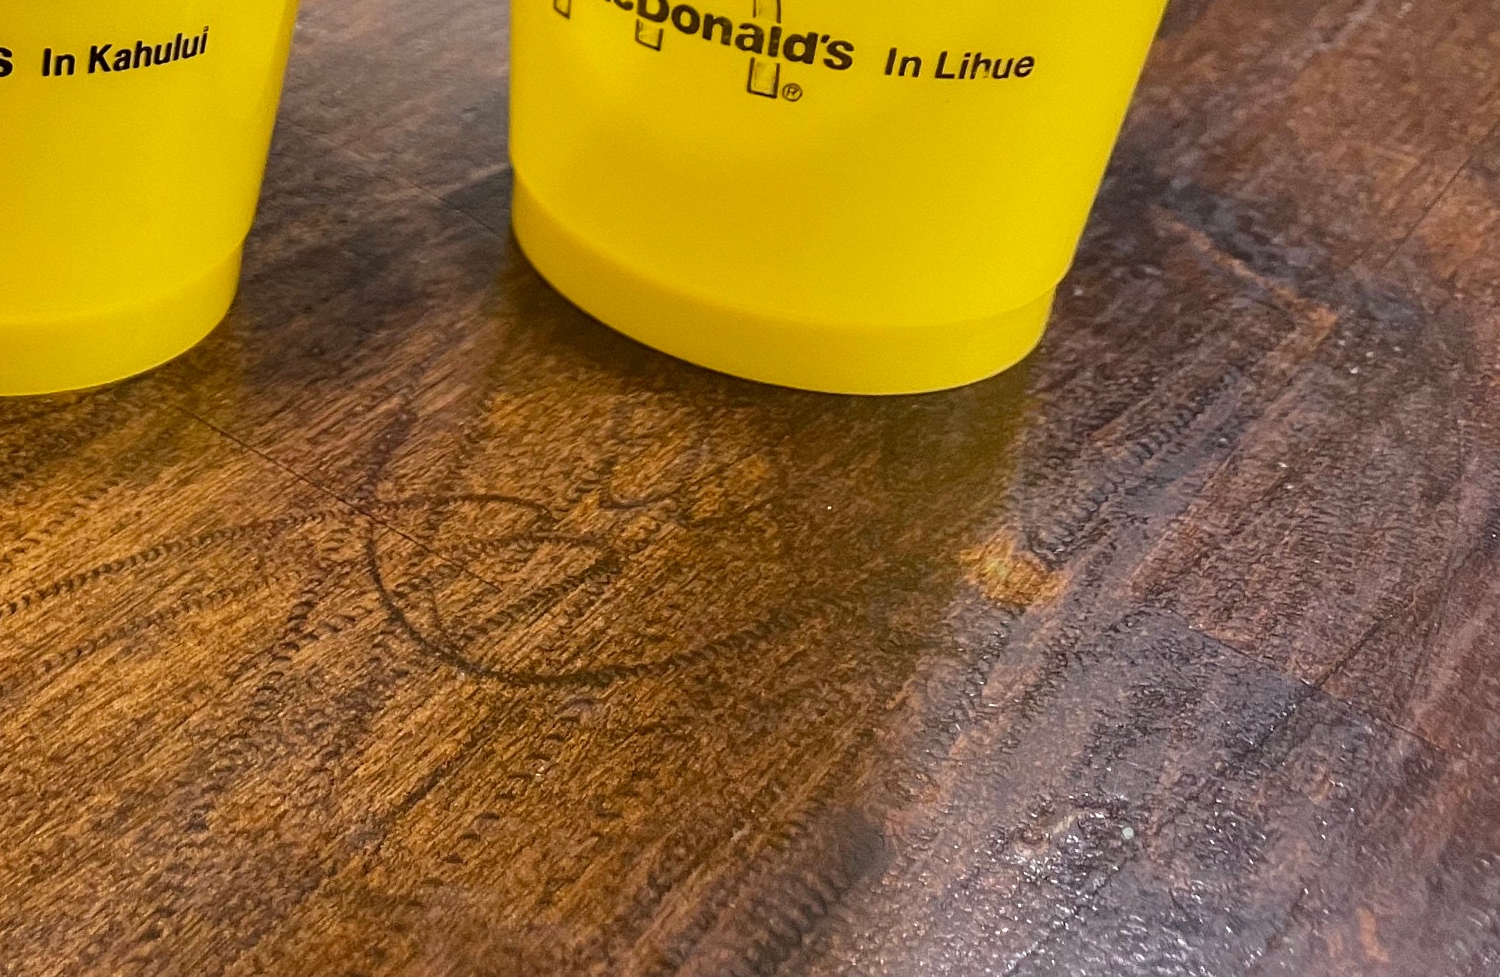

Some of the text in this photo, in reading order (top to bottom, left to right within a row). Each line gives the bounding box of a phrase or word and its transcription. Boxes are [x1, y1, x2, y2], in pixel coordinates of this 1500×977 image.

[41, 47, 76, 77] In
[87, 25, 209, 74] Kahului
[884, 47, 922, 78] In
[934, 50, 1035, 80] Lihue
